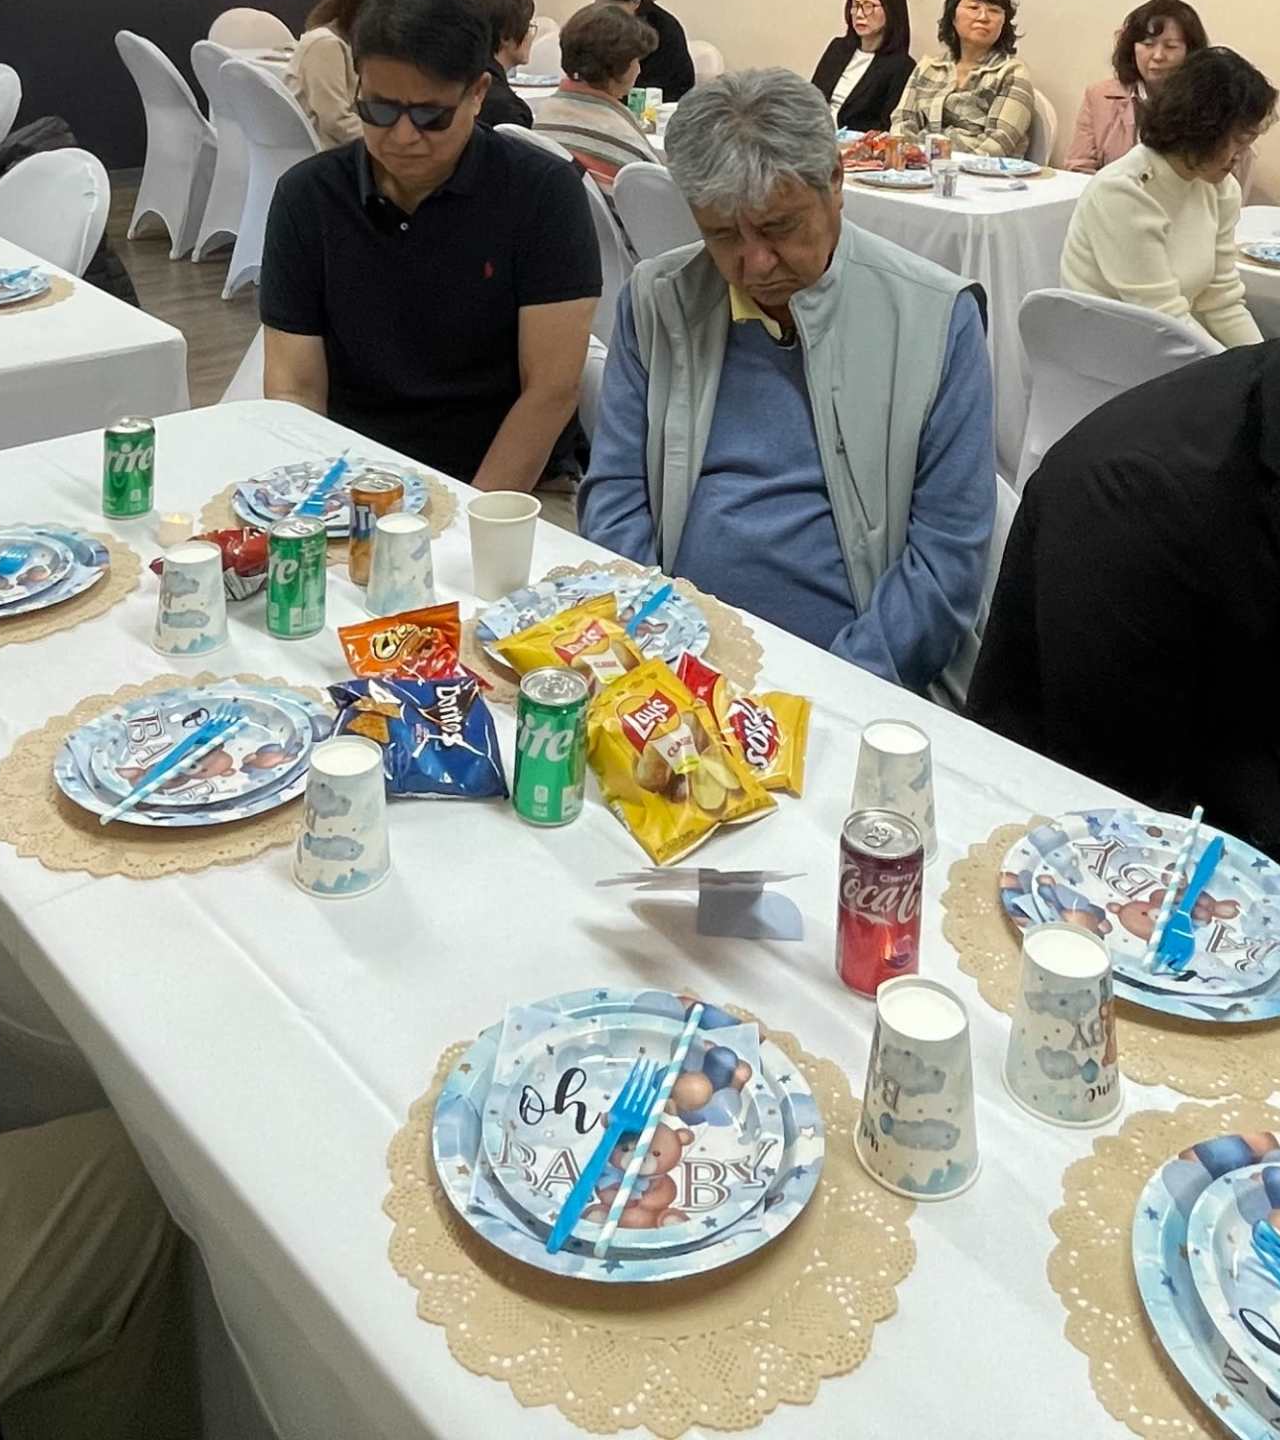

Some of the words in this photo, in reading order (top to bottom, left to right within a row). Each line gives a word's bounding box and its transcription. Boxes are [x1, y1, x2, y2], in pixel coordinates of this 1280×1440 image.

[436, 685, 464, 747] Doritos
[623, 697, 670, 741] Lay's
[518, 1067, 603, 1135] oh
